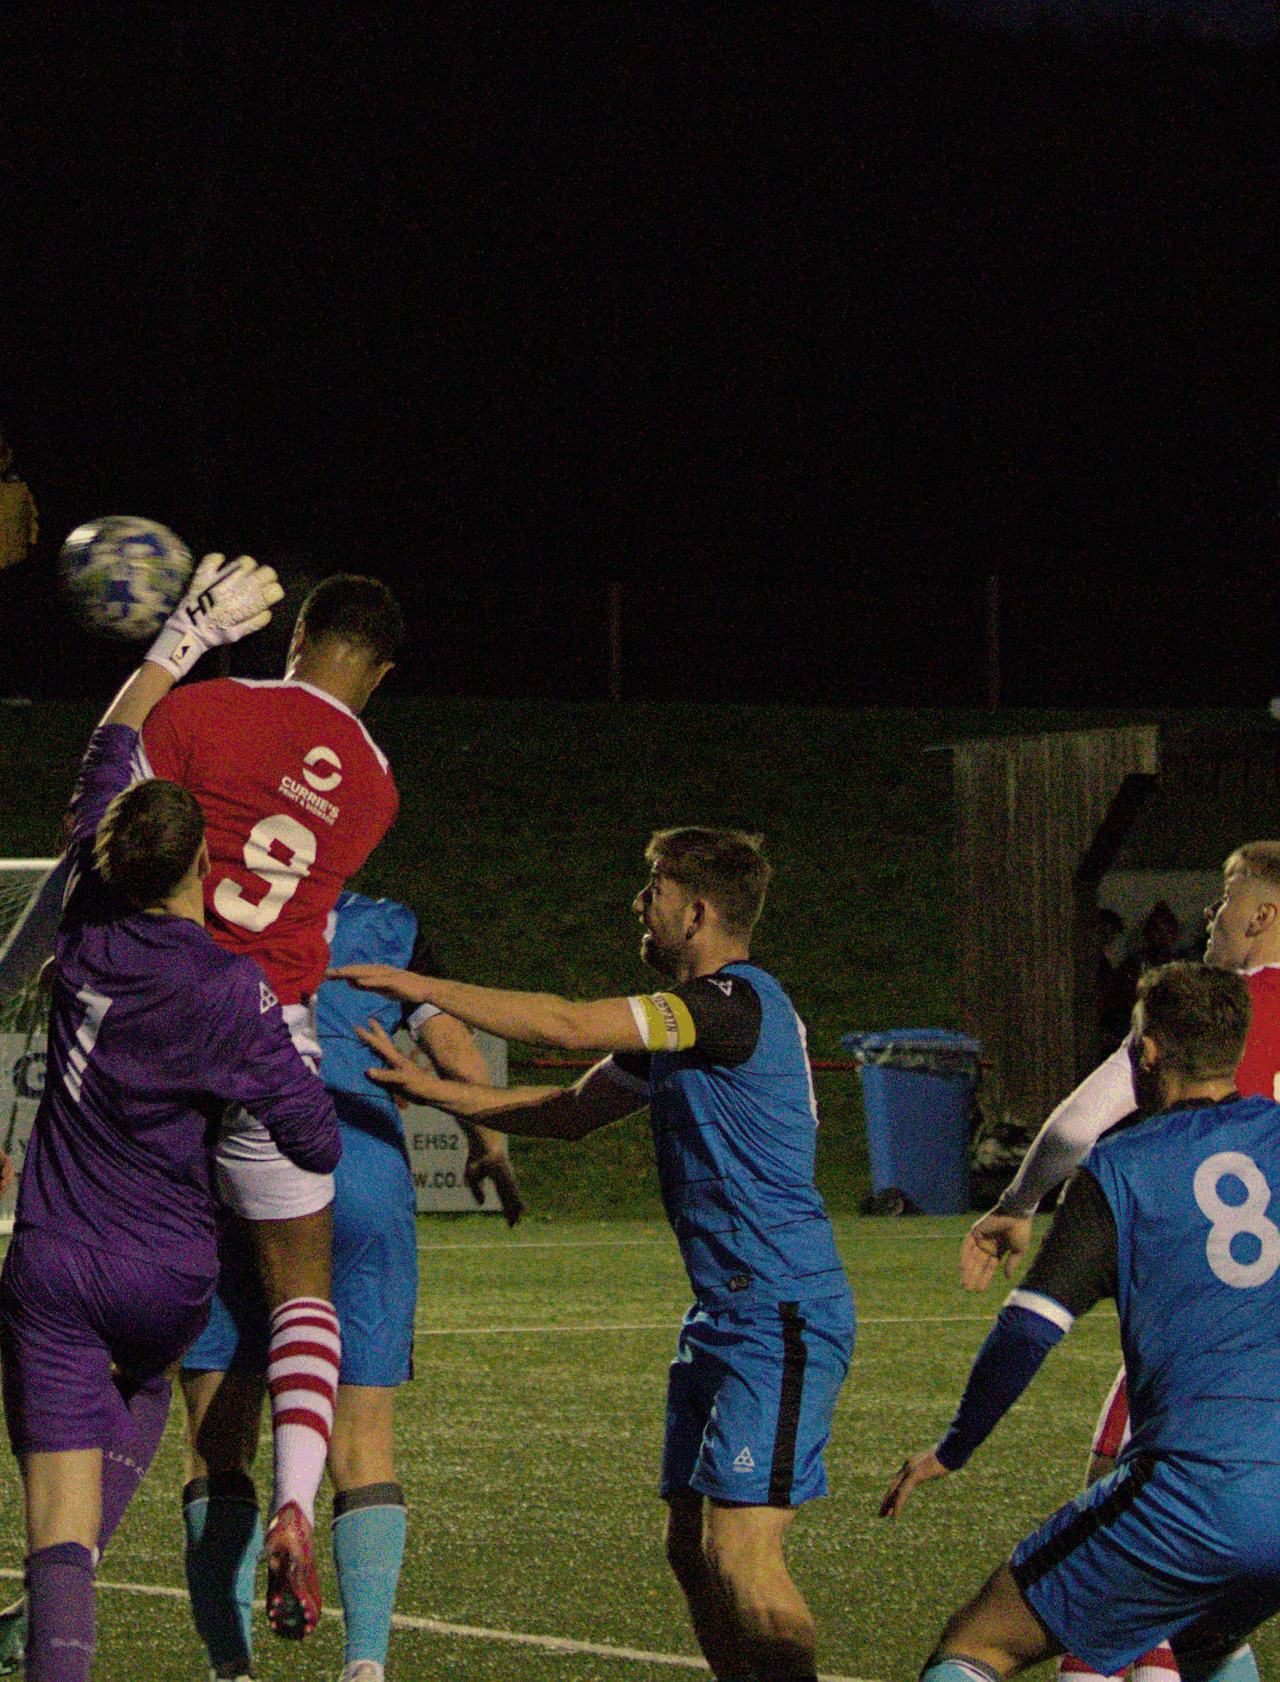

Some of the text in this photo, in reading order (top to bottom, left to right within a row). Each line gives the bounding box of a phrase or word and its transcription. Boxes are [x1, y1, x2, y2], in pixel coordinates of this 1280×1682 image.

[281, 775, 340, 819] CURRIE'S
[213, 813, 317, 932] 9
[413, 1134, 459, 1151] EH52
[1193, 1151, 1280, 1289] 8
